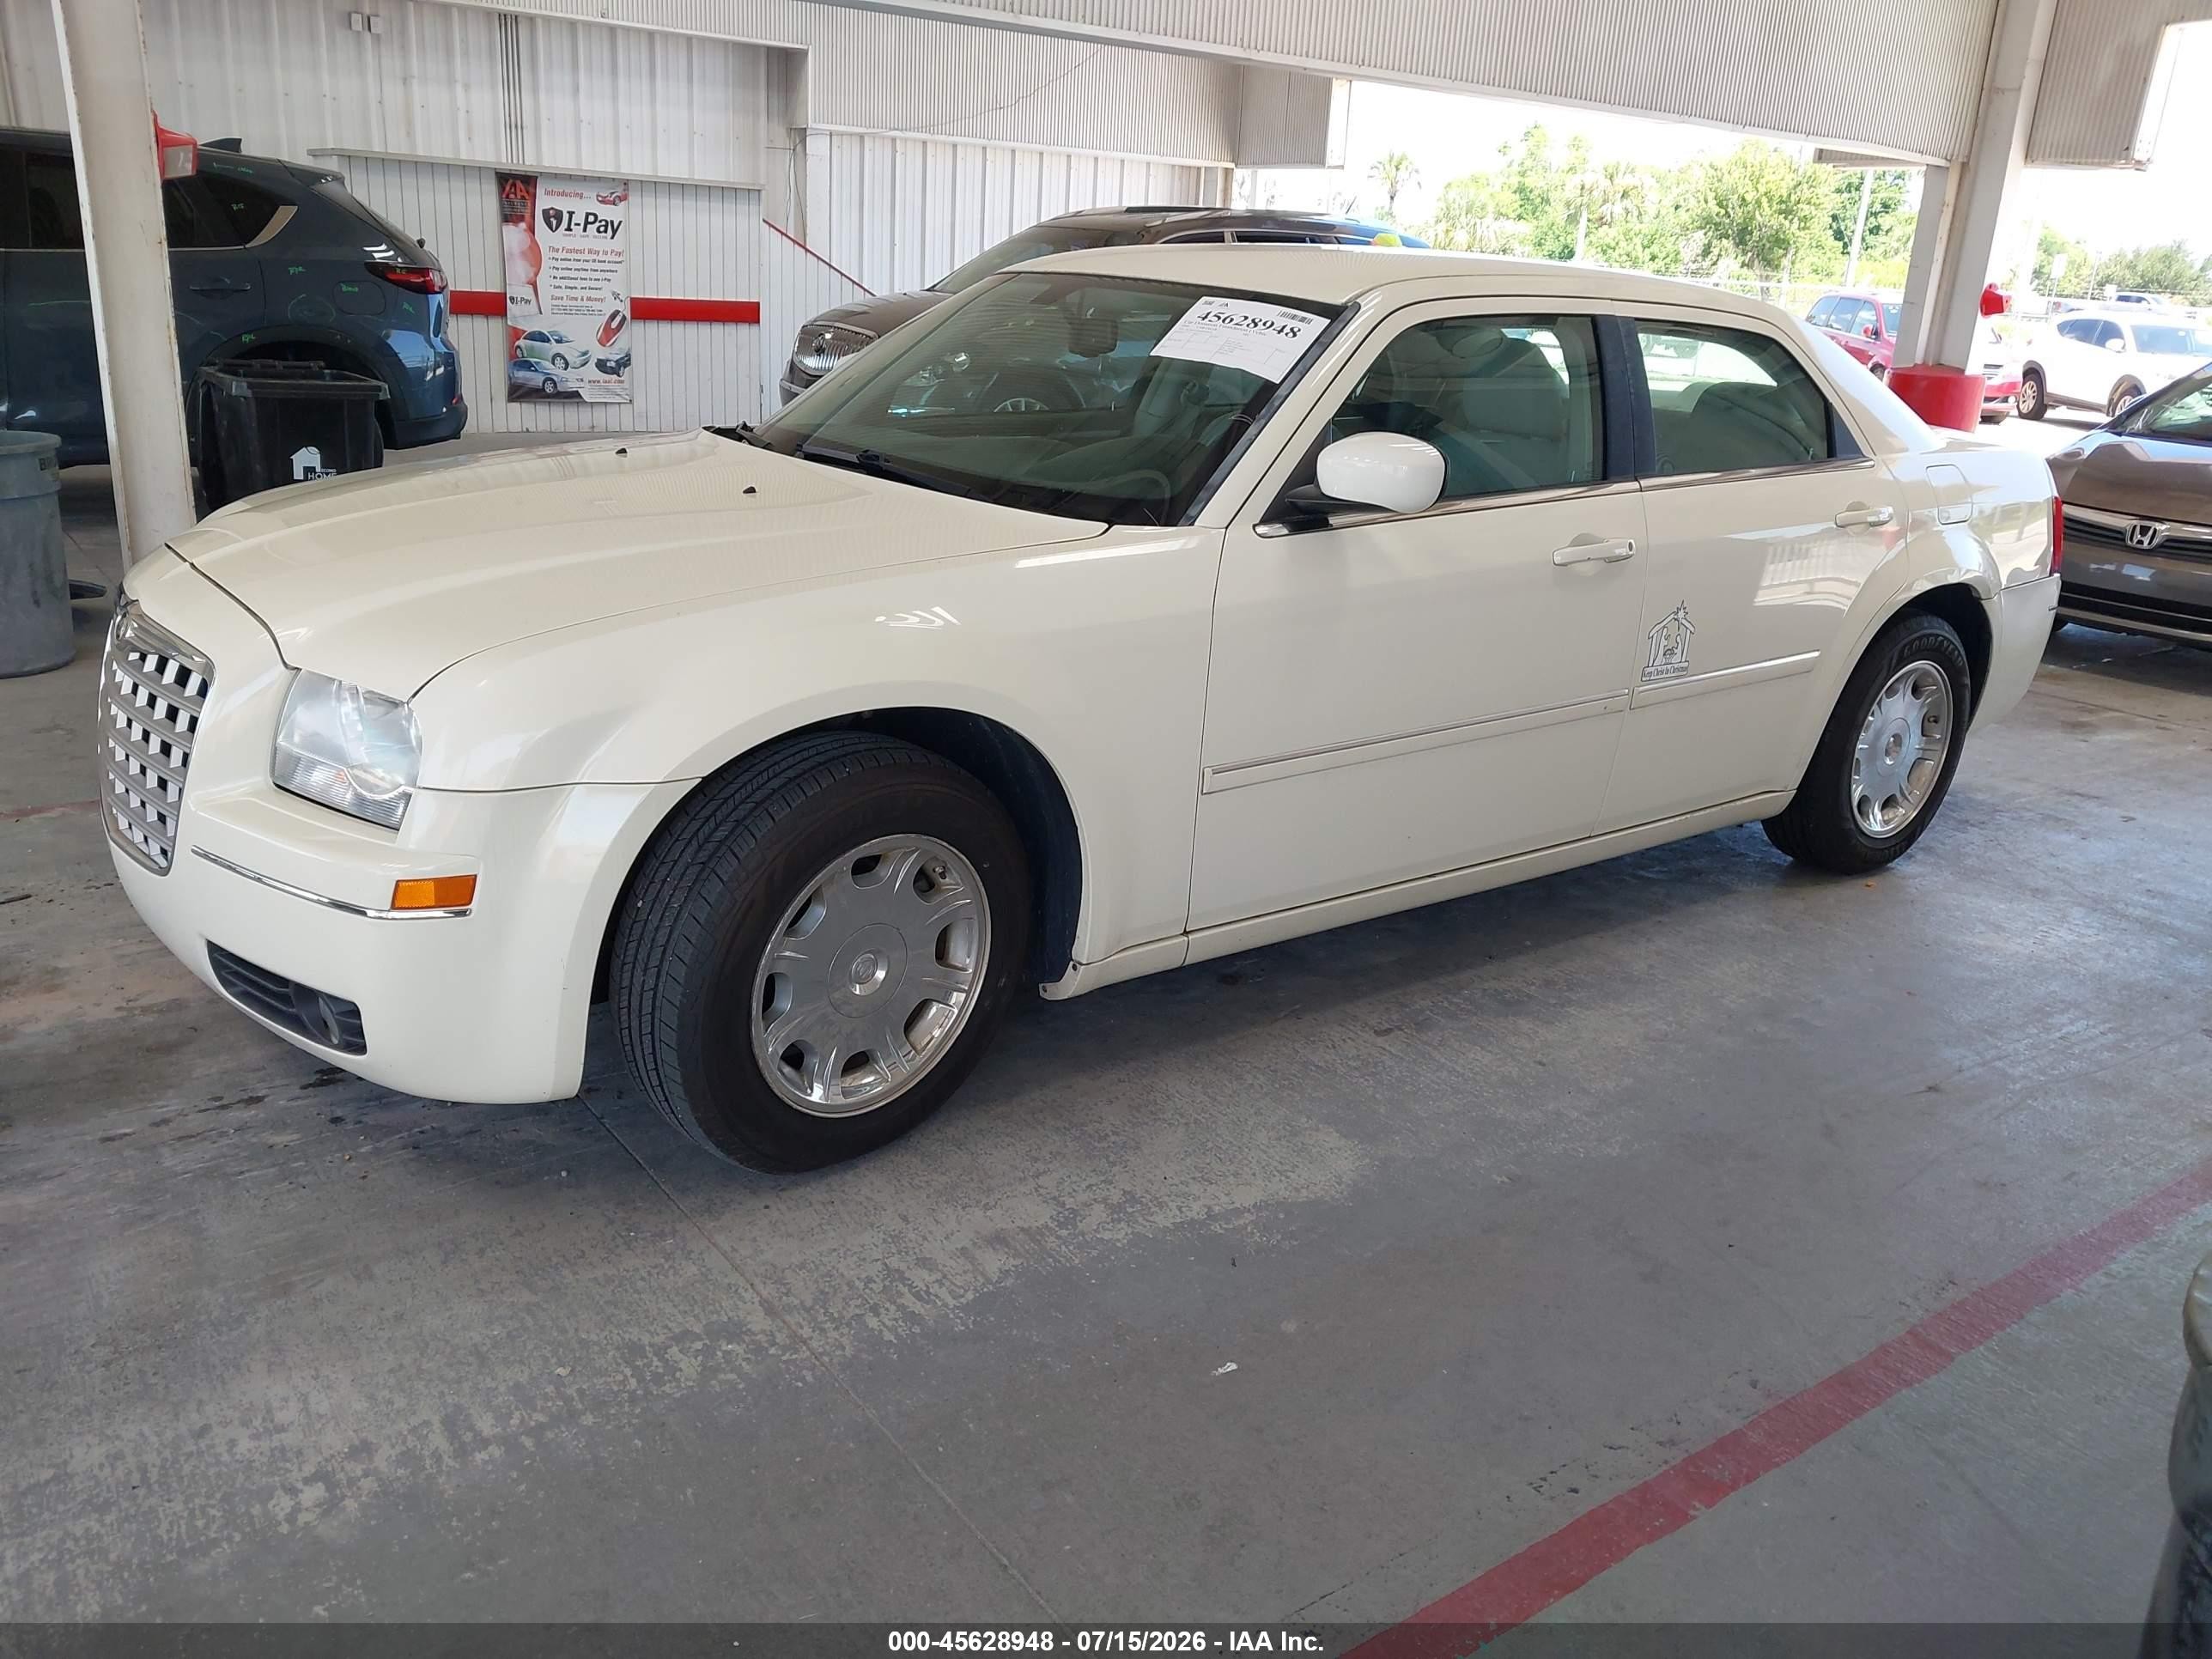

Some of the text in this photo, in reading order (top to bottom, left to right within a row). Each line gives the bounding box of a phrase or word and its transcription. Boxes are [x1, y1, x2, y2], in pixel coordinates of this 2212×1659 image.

[544, 188, 591, 199] Introducing...
[564, 210, 623, 240] I-Pay
[562, 246, 586, 255] Fastest
[587, 247, 600, 257] Way
[611, 249, 624, 258] Pay!
[515, 296, 532, 306] I-Pay
[1197, 310, 1302, 339] 45628948
